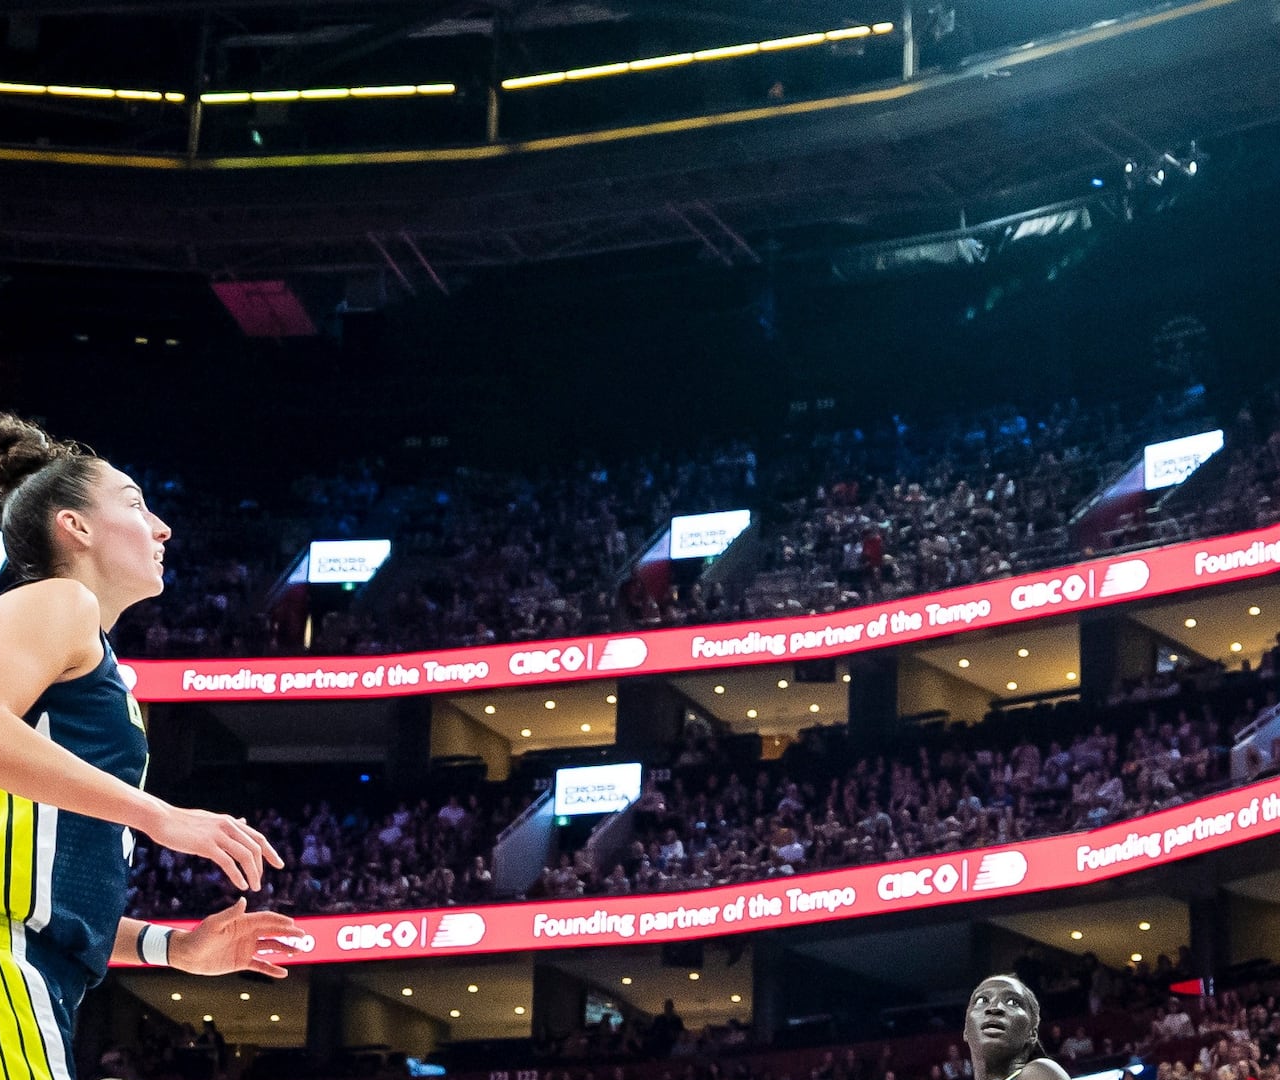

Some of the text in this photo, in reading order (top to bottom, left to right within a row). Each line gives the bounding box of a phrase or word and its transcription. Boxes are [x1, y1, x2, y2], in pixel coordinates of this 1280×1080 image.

[1010, 579, 1061, 610] CIBC
[692, 599, 991, 659] Founding partner of the Tempo
[182, 659, 488, 694] Founding partner of the Tempo
[508, 651, 561, 676] CIBC
[1076, 831, 1161, 872] Founding
[1163, 810, 1235, 856] partner
[1237, 796, 1261, 829] of
[877, 869, 932, 901] CIBC
[533, 886, 856, 938] Founding partner of the Tempo
[337, 923, 393, 951] CIBC
